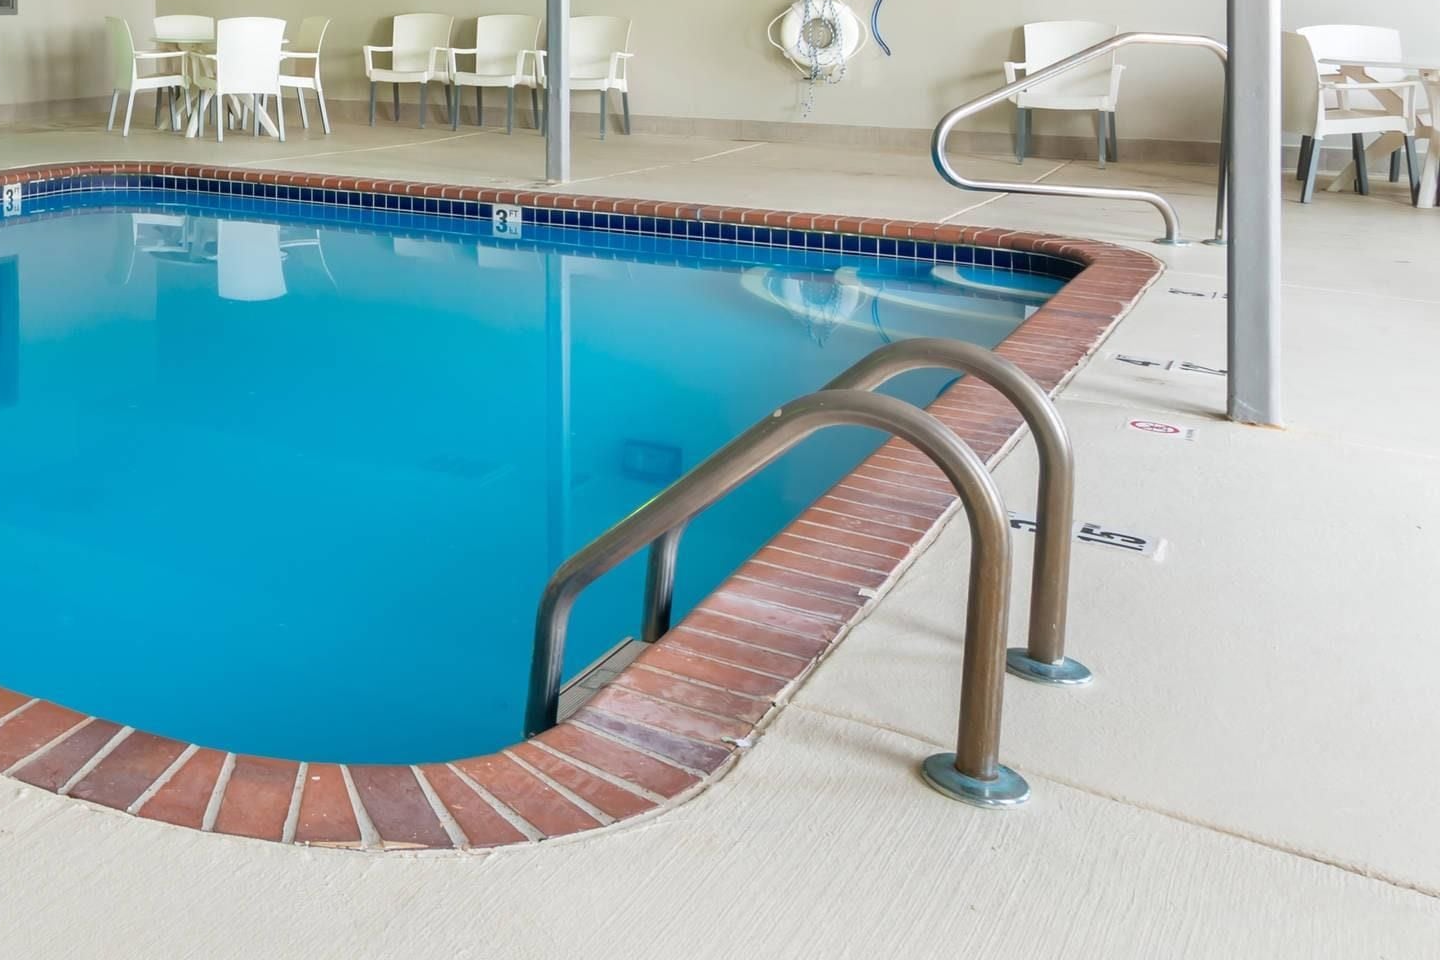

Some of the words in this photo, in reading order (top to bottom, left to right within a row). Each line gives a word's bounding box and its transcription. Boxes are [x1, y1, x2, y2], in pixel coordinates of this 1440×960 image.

[6, 189, 14, 205] 3
[495, 209, 508, 227] 3
[1115, 357, 1161, 366] 4
